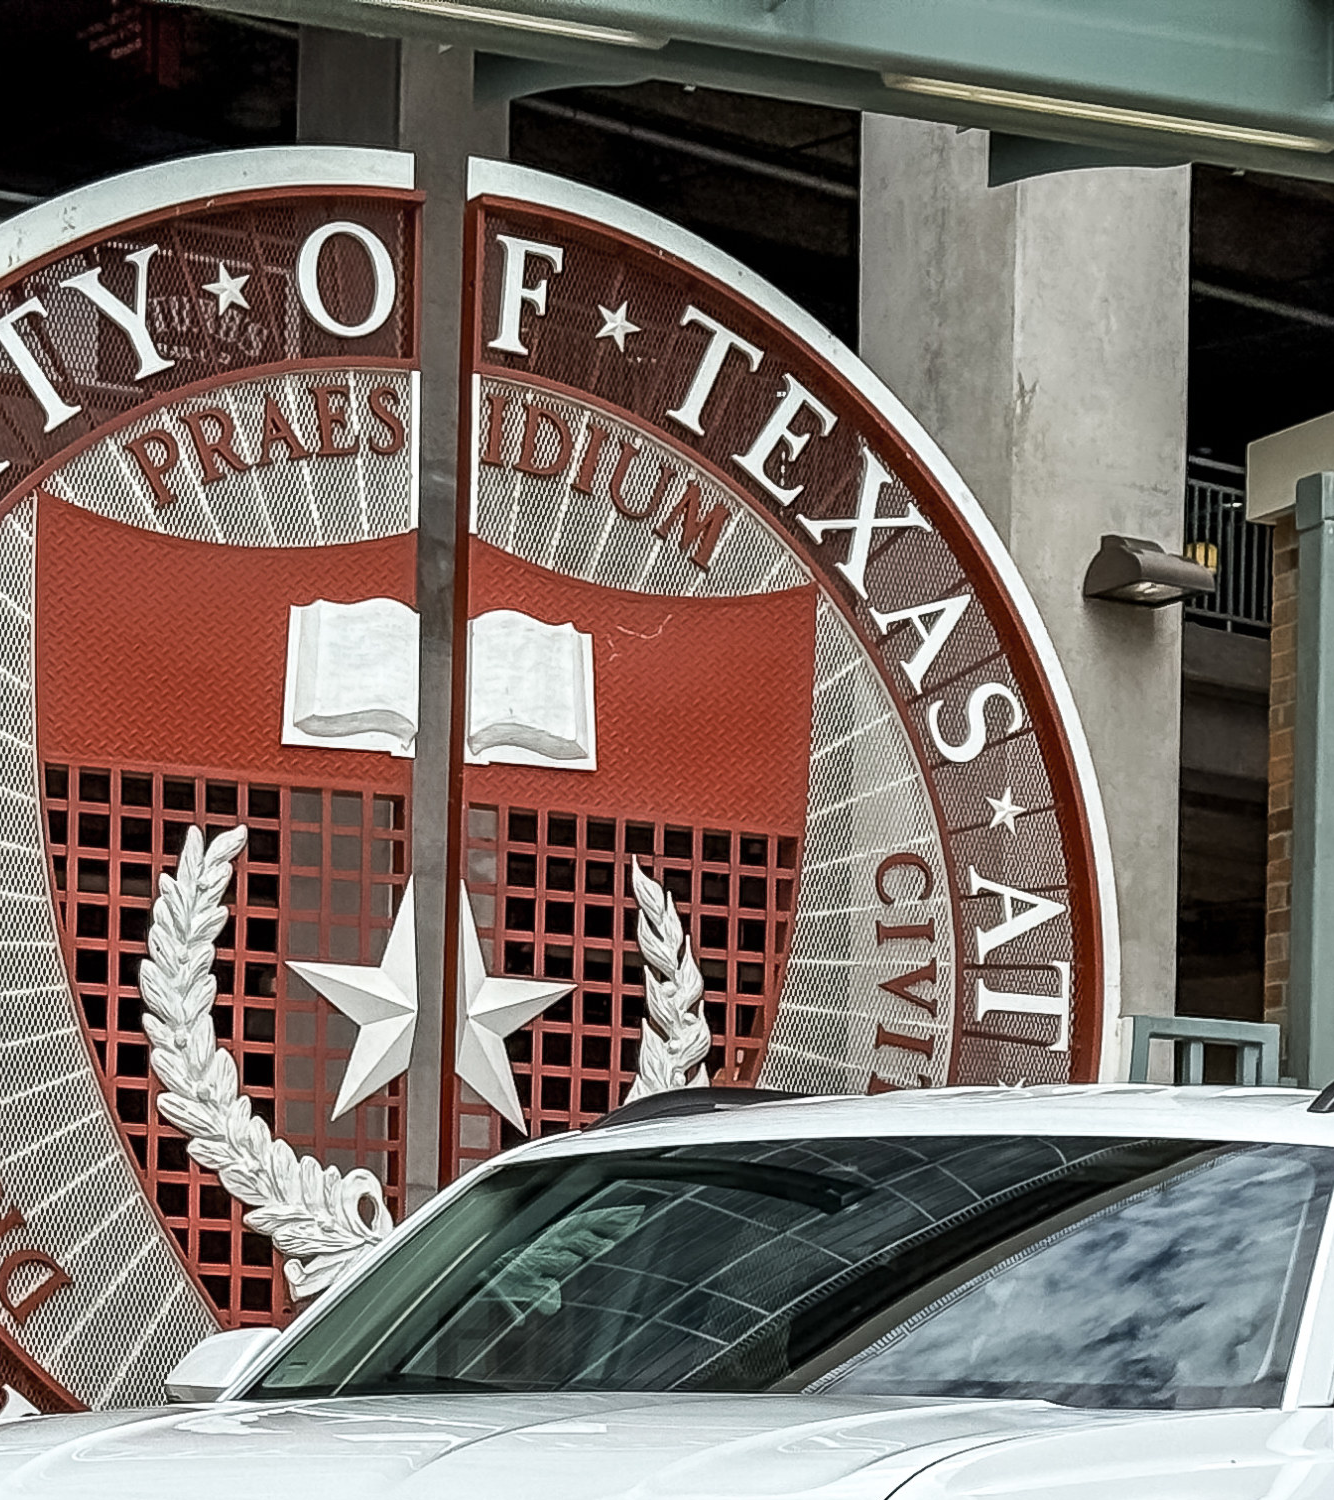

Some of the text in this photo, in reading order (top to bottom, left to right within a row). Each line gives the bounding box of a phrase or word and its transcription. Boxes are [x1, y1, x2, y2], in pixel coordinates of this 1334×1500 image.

[298, 221, 565, 356] OF
[666, 304, 1024, 764] TEXAS
[969, 864, 1071, 1052] AT
